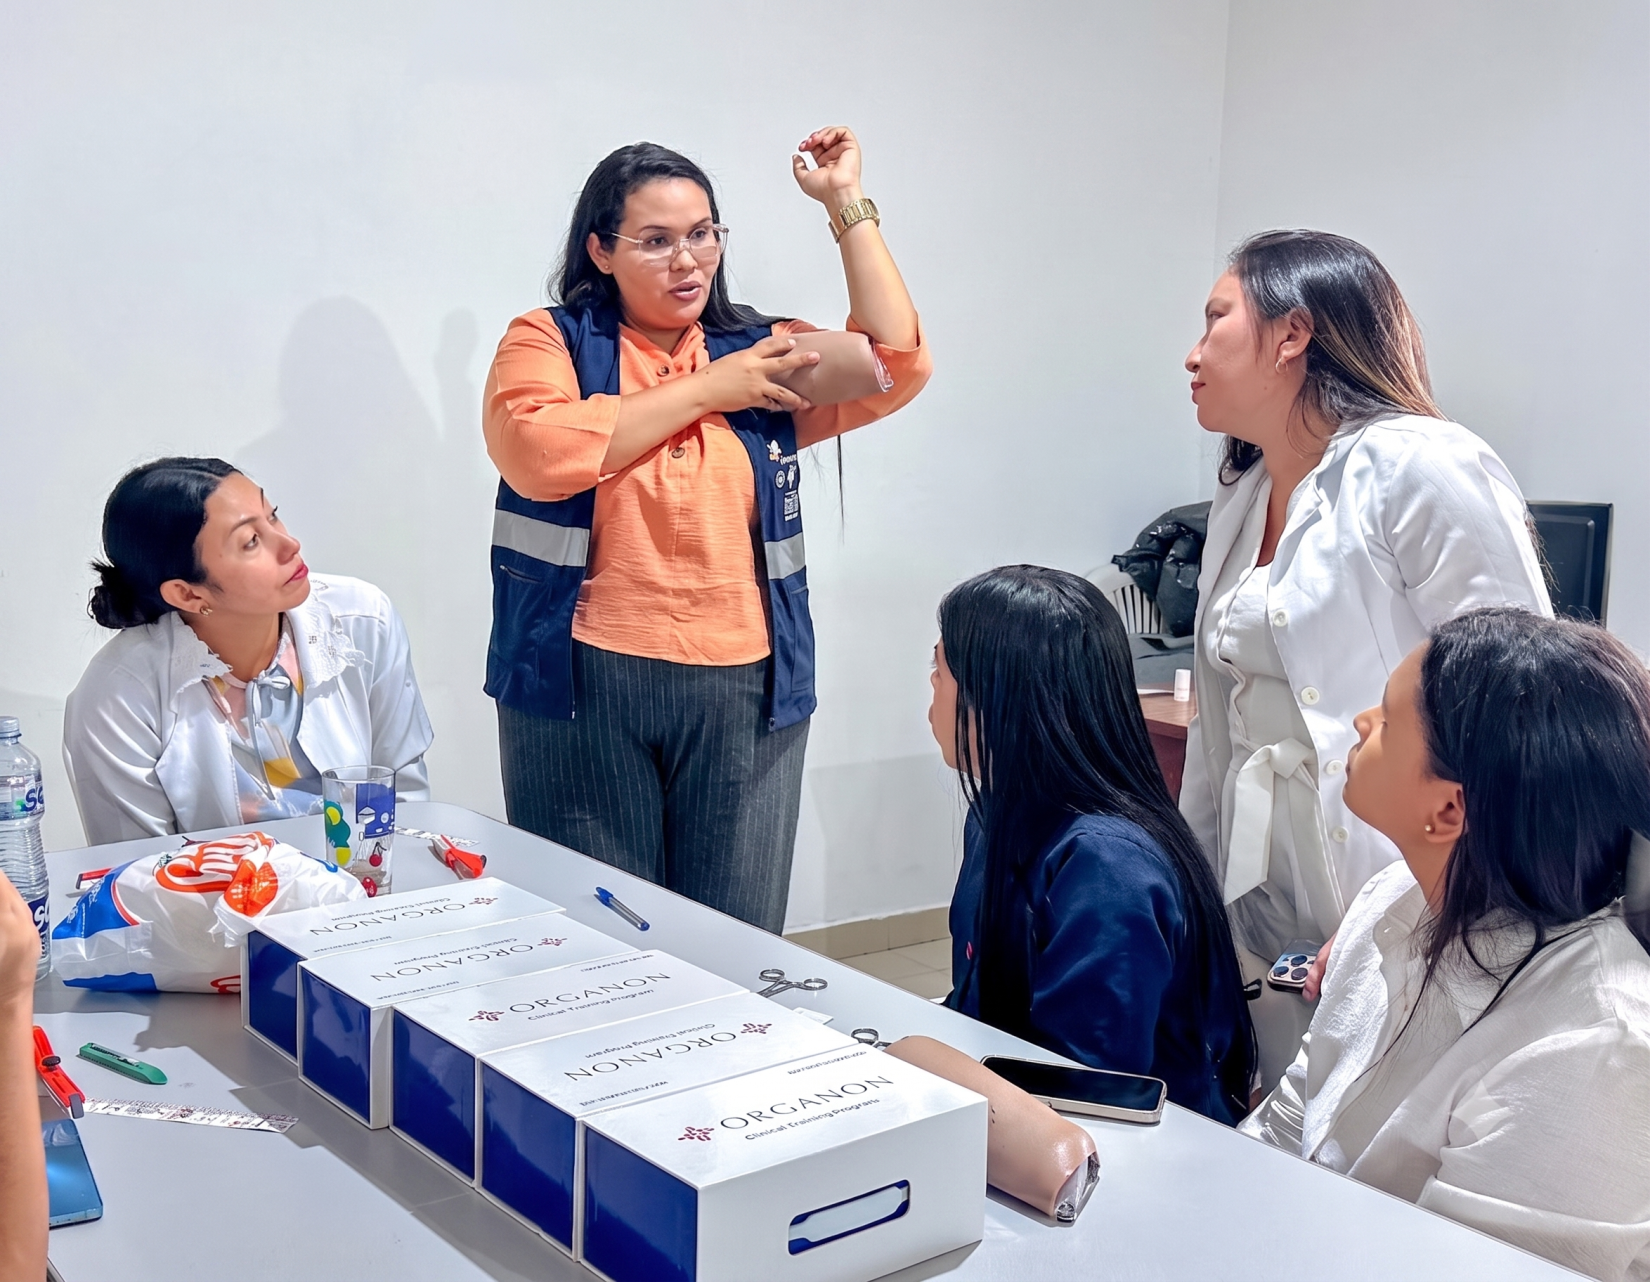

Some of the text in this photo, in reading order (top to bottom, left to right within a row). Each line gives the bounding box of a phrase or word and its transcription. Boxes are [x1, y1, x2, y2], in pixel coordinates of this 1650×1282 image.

[309, 903, 466, 935] ORGANON
[370, 944, 533, 981] ORGANON
[509, 972, 671, 1013] ORGANON
[564, 1031, 736, 1081] ORGANON
[720, 1075, 894, 1130] ORGANON
[744, 1124, 787, 1141] Clinical
[787, 1110, 833, 1129] Training
